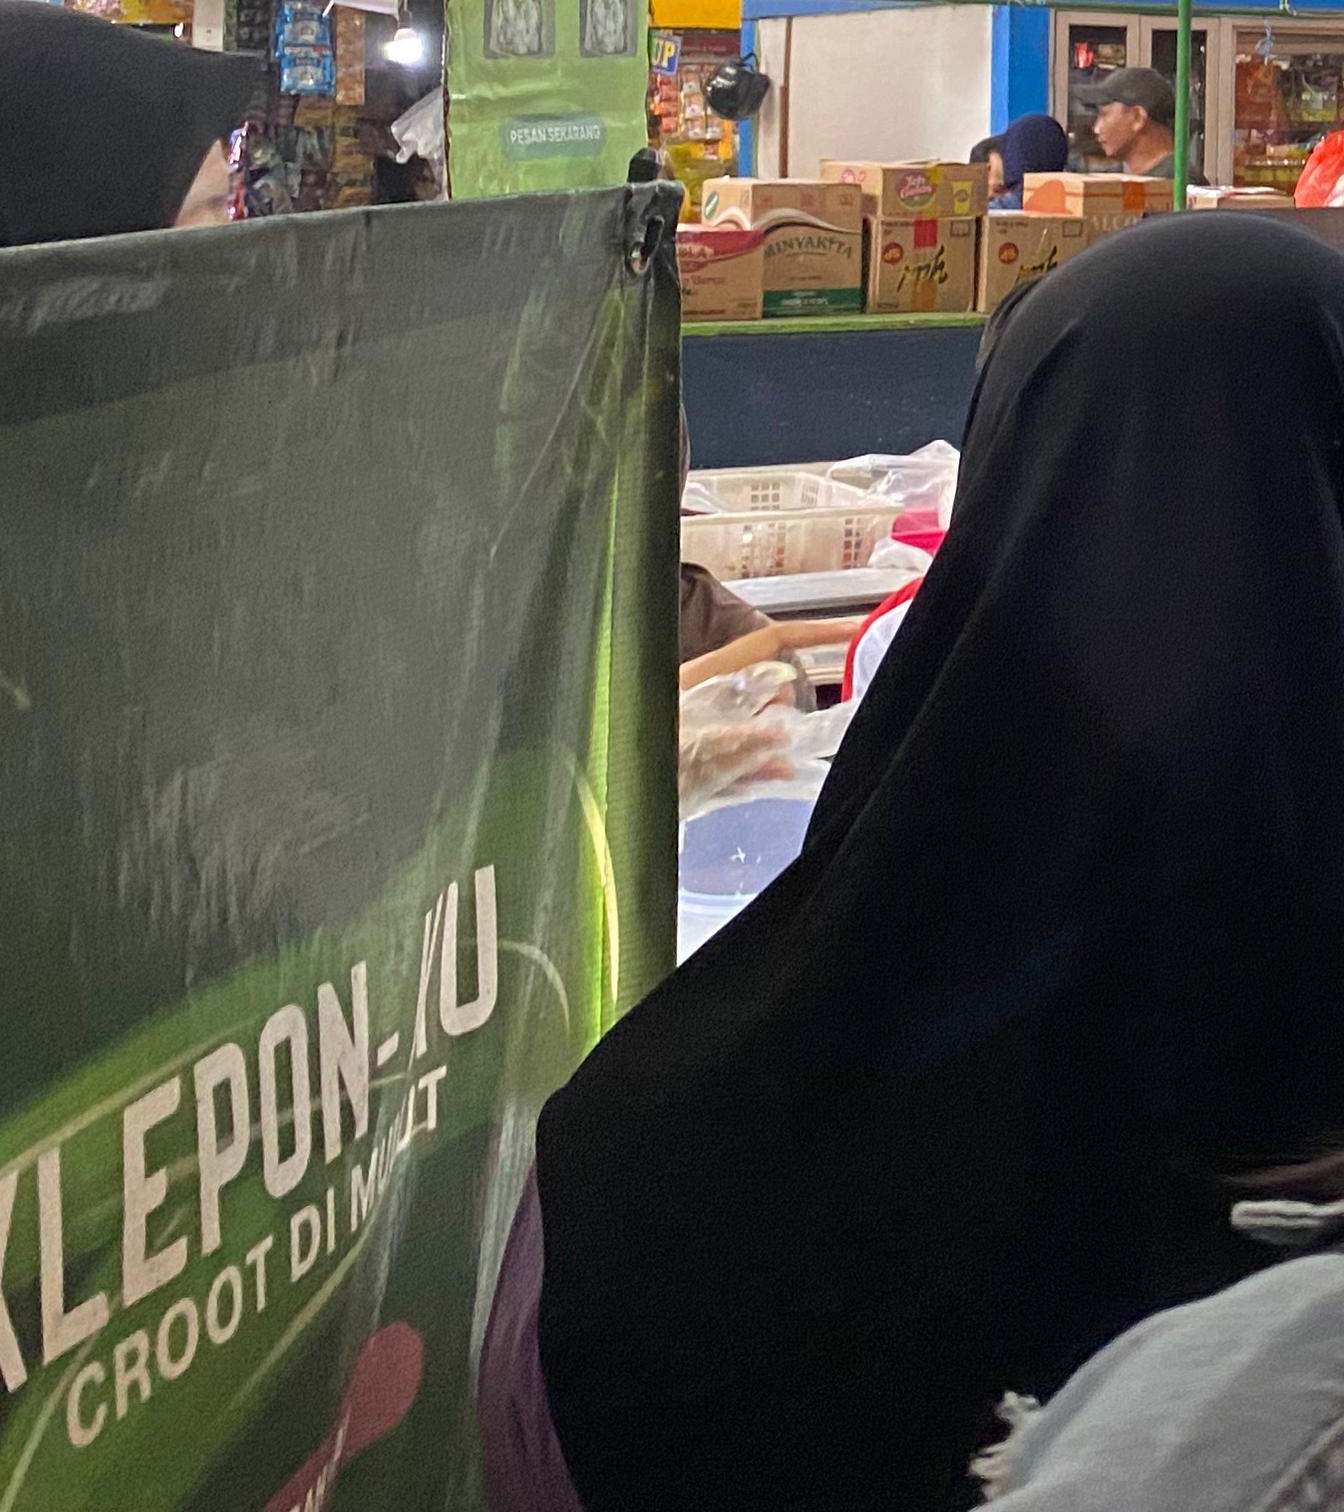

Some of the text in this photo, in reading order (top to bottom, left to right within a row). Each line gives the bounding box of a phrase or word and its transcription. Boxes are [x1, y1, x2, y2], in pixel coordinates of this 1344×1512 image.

[510, 128, 547, 145] PESAN
[0, 864, 500, 1390] LEPON-U
[66, 1235, 274, 1449] CROOT
[289, 1187, 337, 1284] DI
